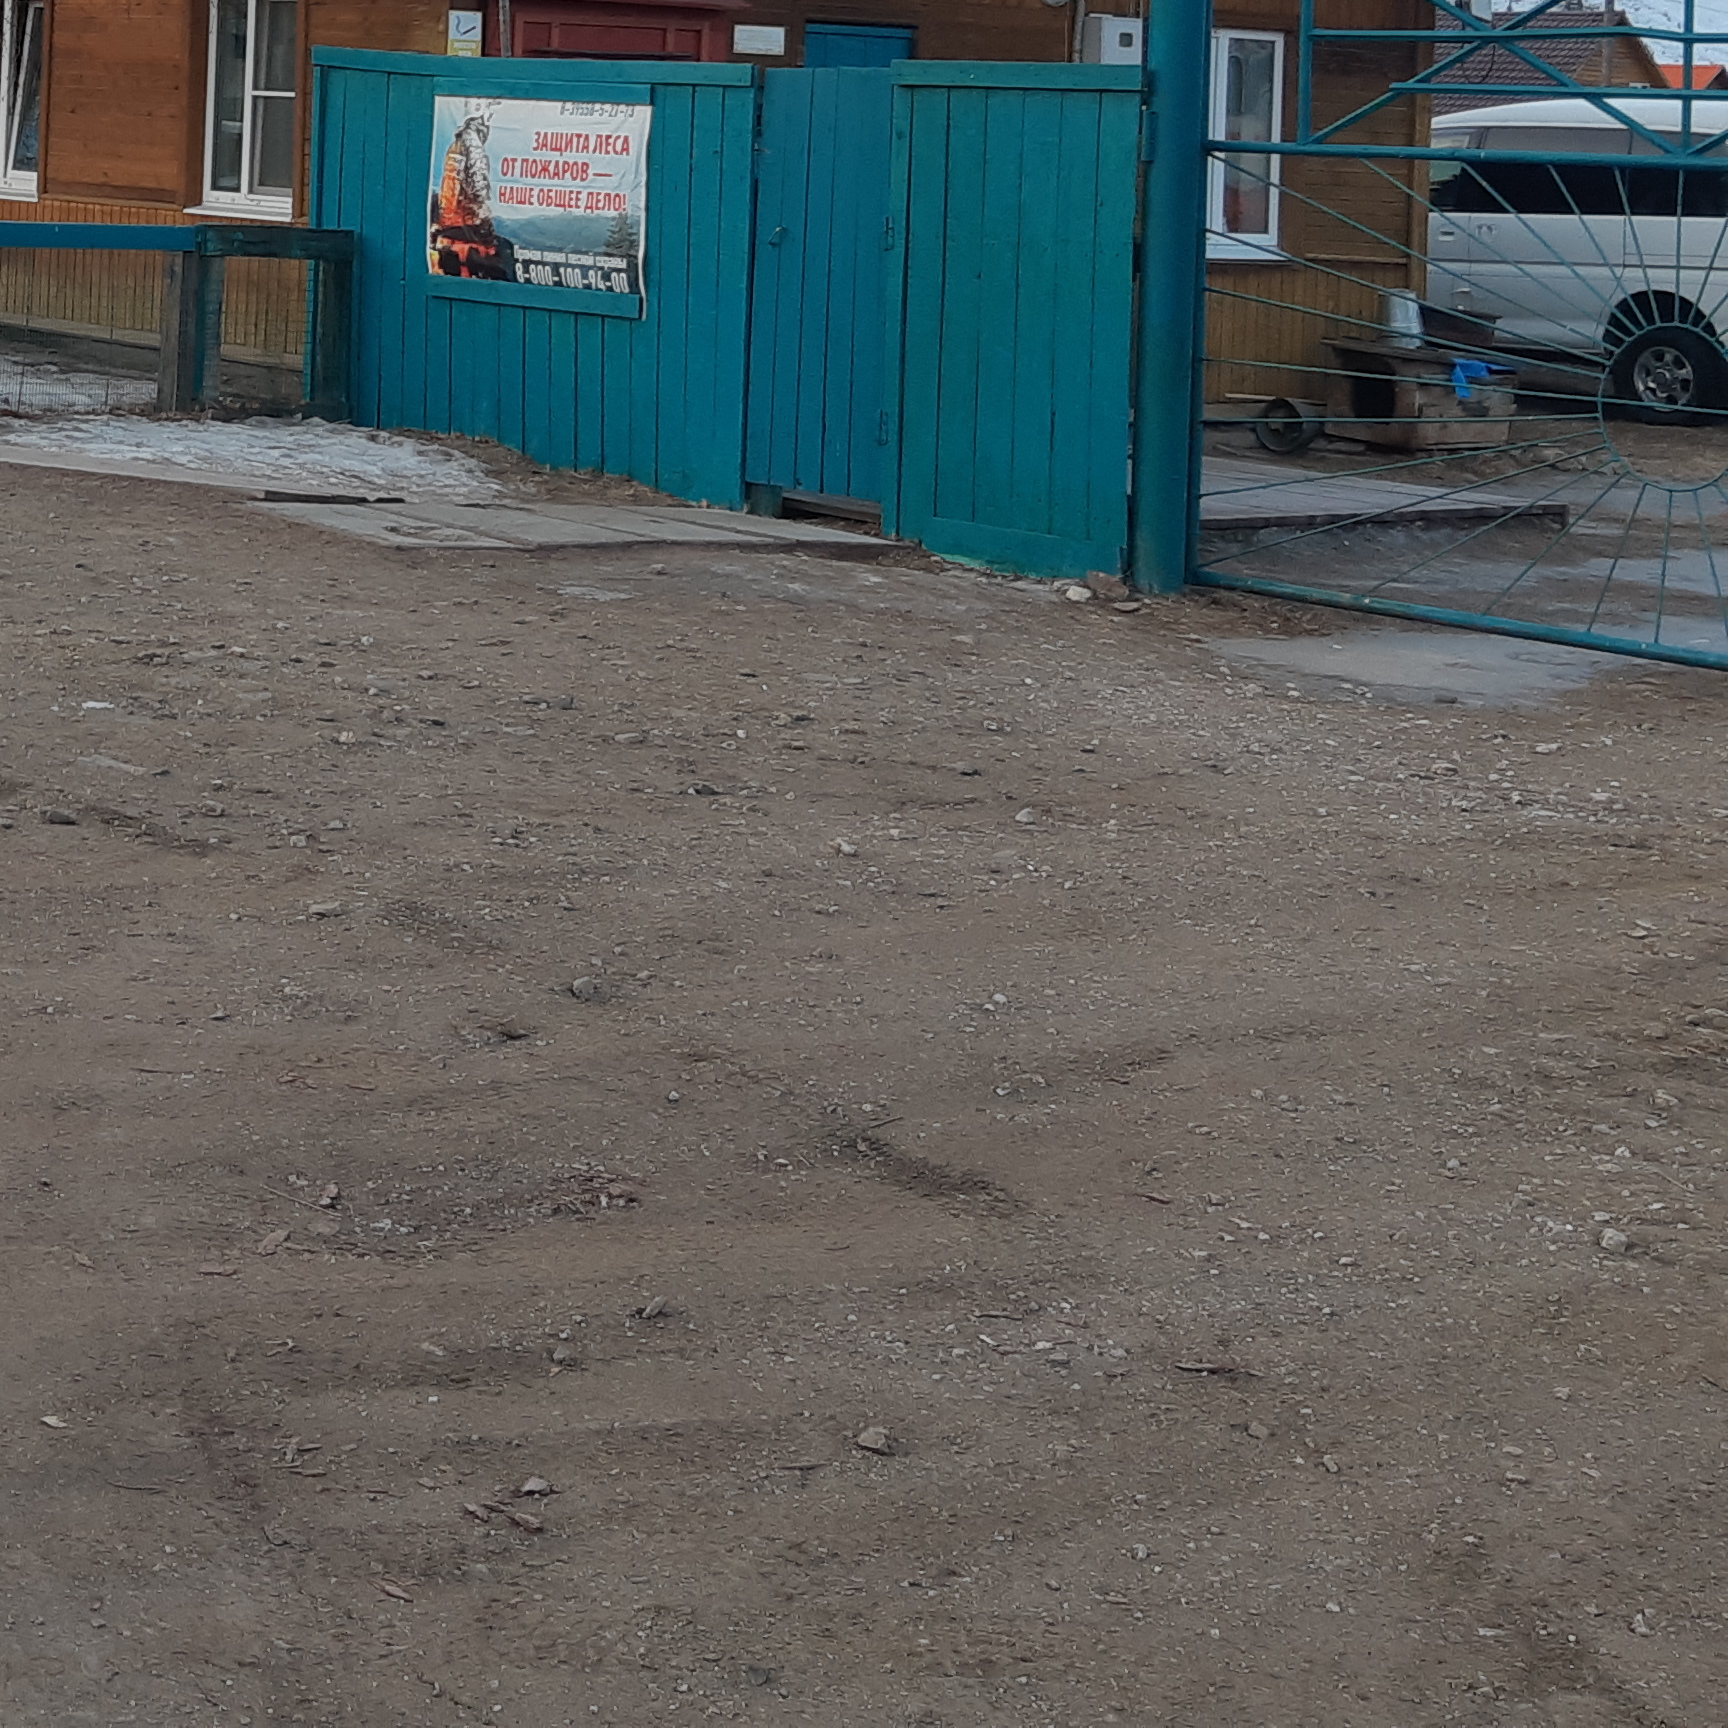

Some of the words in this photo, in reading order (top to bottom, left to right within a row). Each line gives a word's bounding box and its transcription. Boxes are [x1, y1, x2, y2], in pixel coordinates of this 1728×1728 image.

[532, 131, 590, 157] ЗАЩИТА
[592, 134, 630, 156] ЛЕСА
[501, 157, 518, 177] ОТ
[520, 158, 590, 182] ПОЖАРОВ
[498, 185, 534, 206] НАШЕ
[536, 188, 583, 212] ОБЩЕЕ
[584, 191, 627, 214] ДЕЛО!
[515, 262, 630, 293] 8-800-100-94-00
